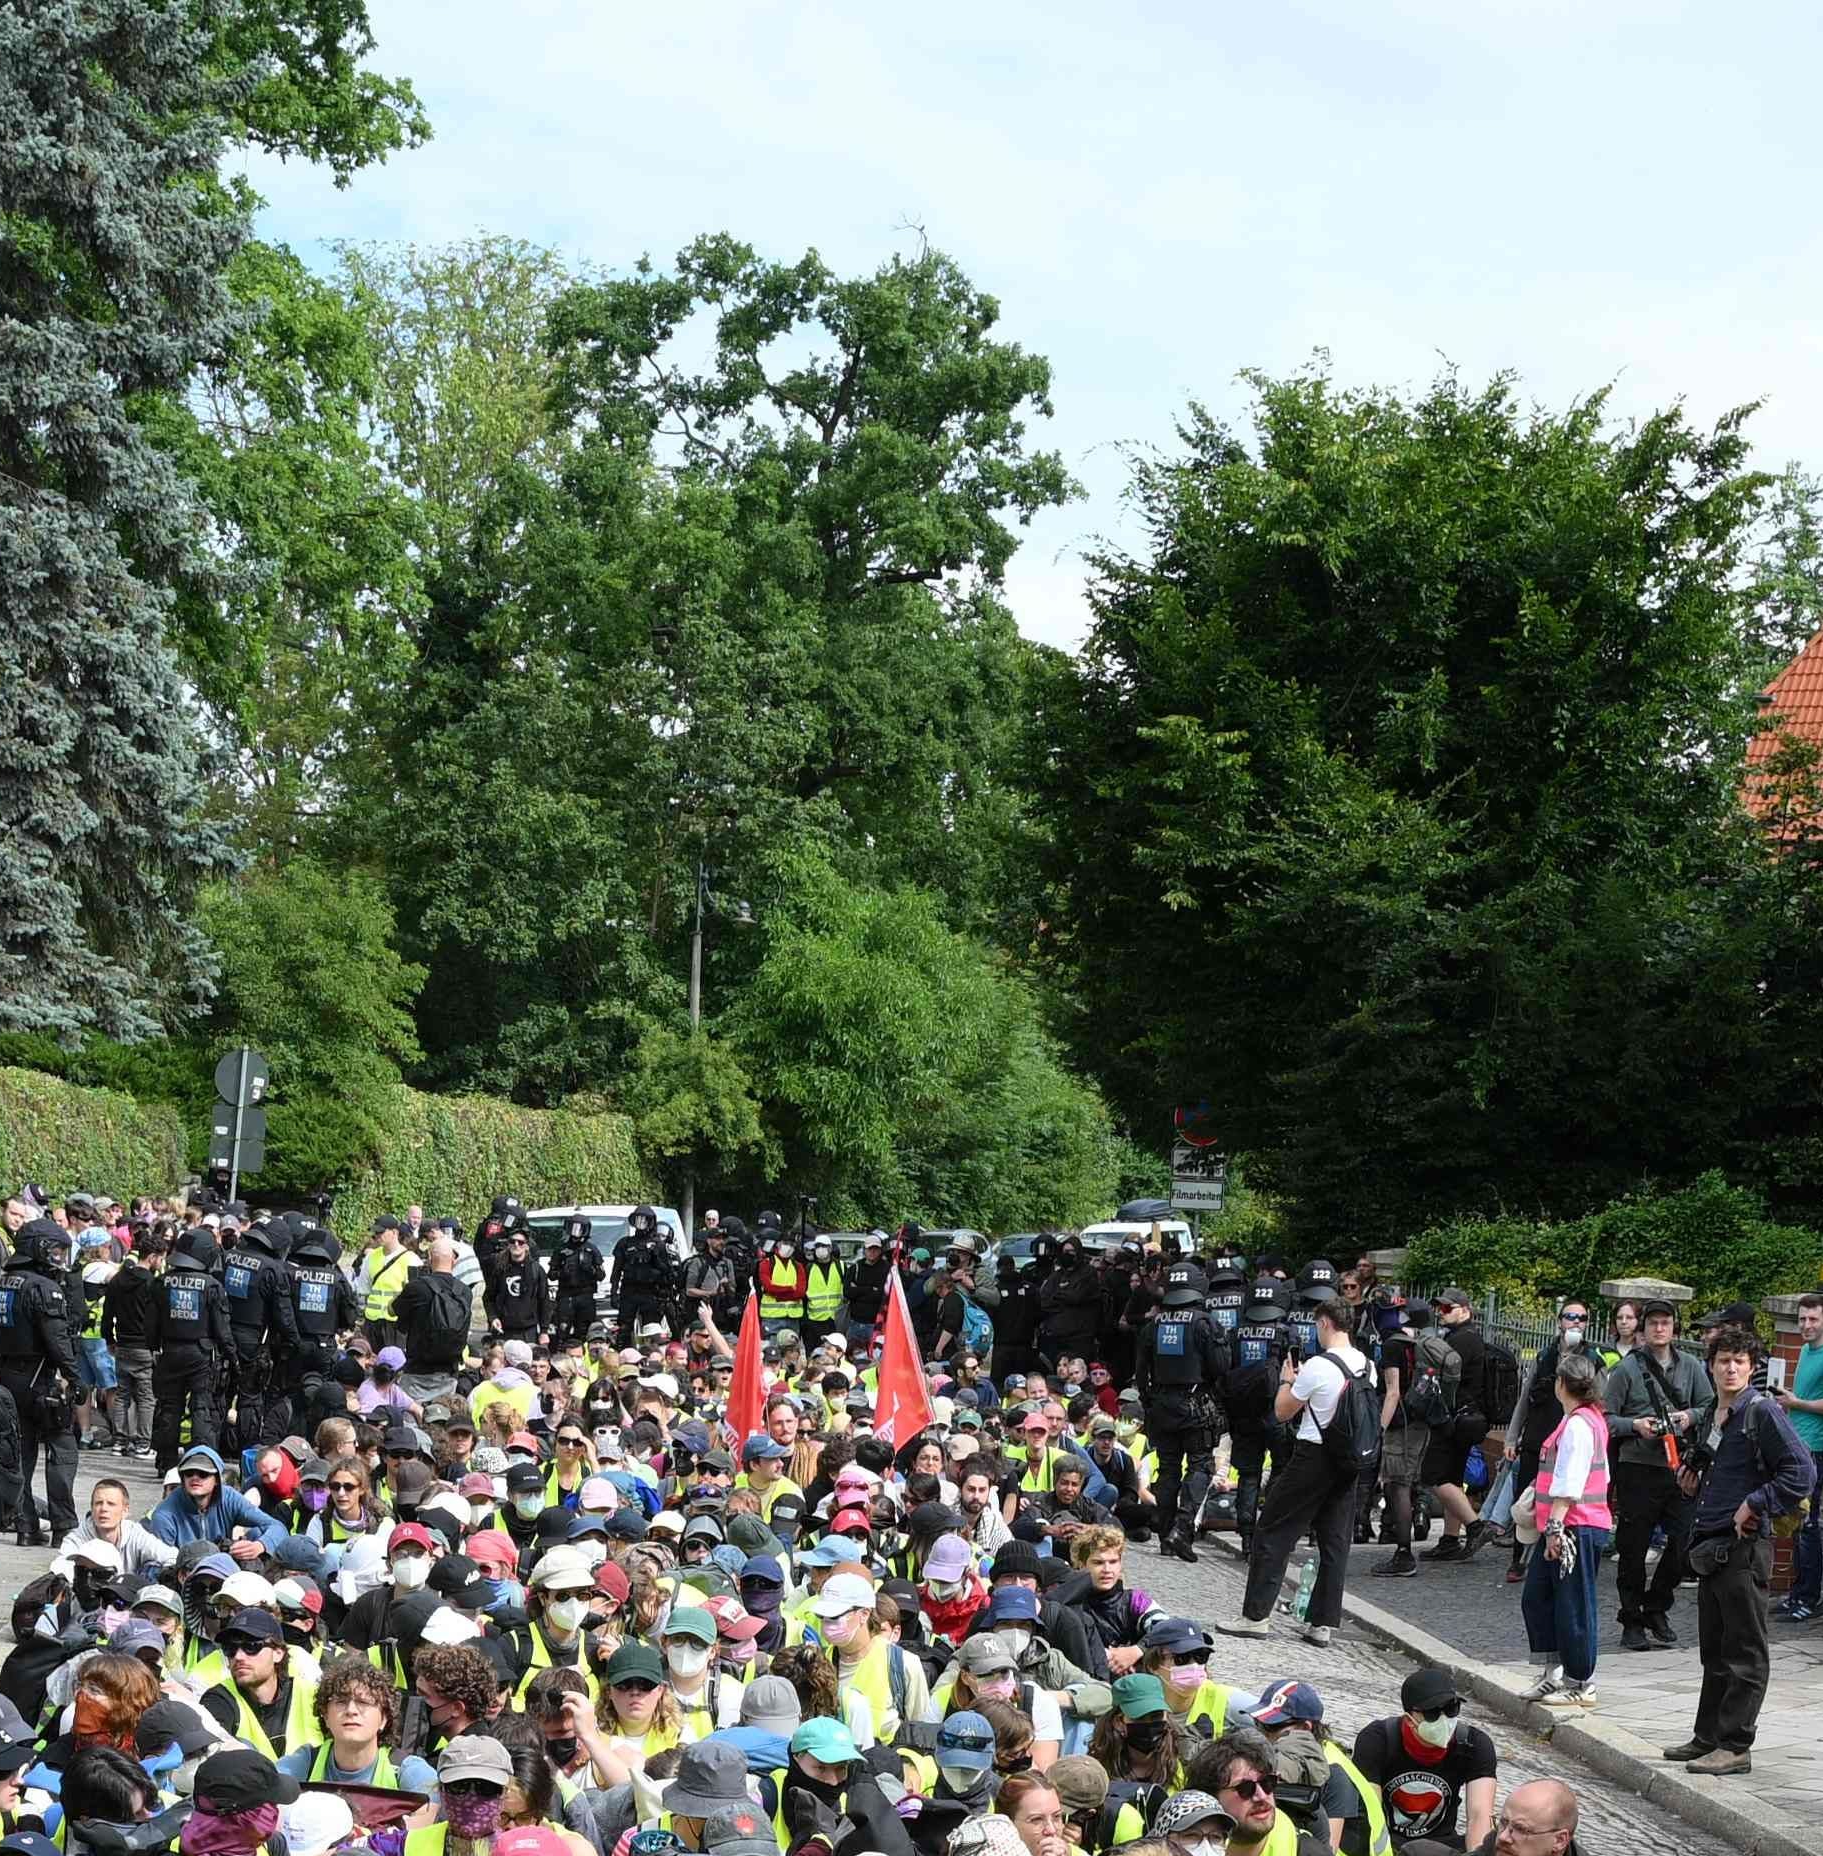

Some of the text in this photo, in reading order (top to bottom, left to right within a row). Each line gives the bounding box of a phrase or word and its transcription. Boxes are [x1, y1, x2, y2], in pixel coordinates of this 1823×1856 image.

[1171, 1189, 1223, 1201] Filmarbeiten
[227, 1252, 261, 1271] POLIZEI
[232, 1269, 244, 1279] TH
[294, 1270, 335, 1284] POLIZEI
[1169, 1271, 1188, 1282] 222
[1312, 1269, 1331, 1280] 222
[163, 1275, 206, 1290] POLIZEI
[307, 1284, 322, 1294] TH
[1254, 1288, 1274, 1298] 222
[177, 1290, 192, 1300] TH
[1205, 1296, 1242, 1308] POLIZEI
[1155, 1311, 1194, 1323] POLIZEI
[1288, 1311, 1316, 1322] POLIZ
[1165, 1325, 1178, 1335] TH
[1237, 1327, 1276, 1339] POLIZEI
[1297, 1324, 1310, 1335] TH
[1247, 1341, 1261, 1350] TH
[984, 1639, 1000, 1654] NY
